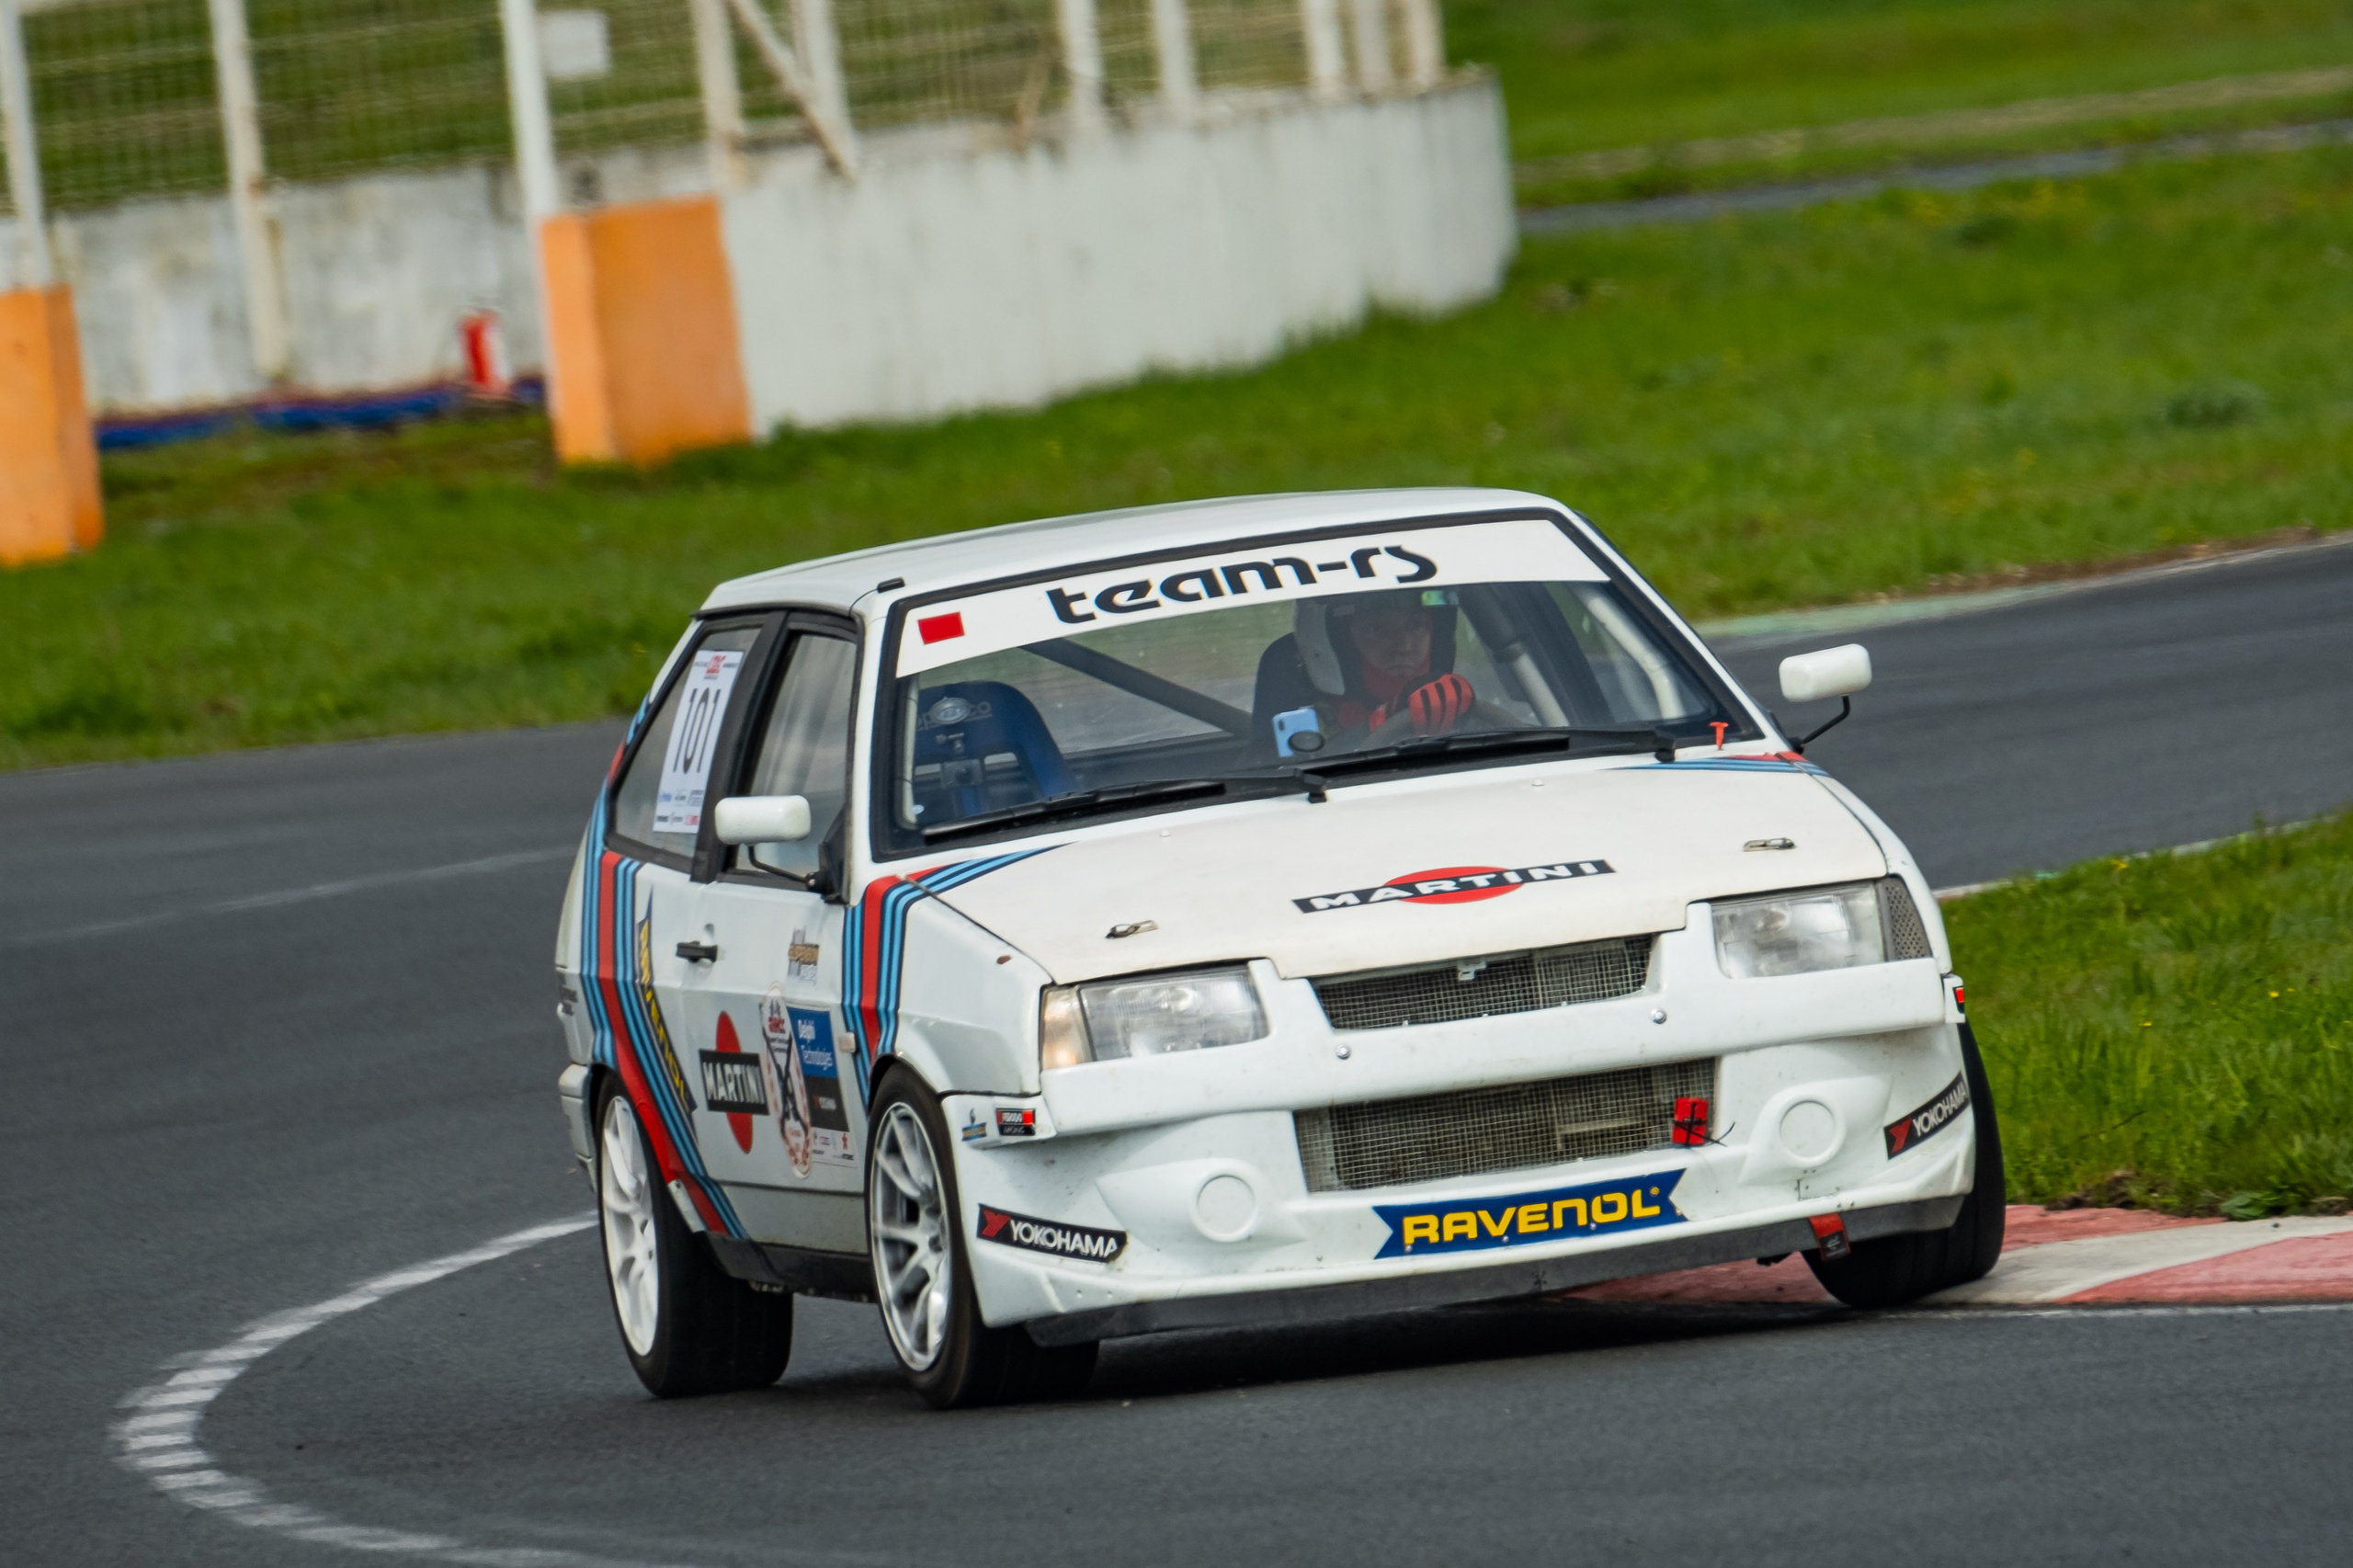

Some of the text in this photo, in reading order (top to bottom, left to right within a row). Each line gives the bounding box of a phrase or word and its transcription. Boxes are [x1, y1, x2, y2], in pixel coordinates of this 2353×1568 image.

[1046, 544, 1438, 624] team-rs
[1308, 861, 1600, 911] MARTINI
[701, 1061, 767, 1105] MARTINI
[1912, 1082, 1969, 1138] YOKOHAMA
[1010, 1219, 1119, 1258] YOKOHAMA
[1403, 1188, 1662, 1245] RAVENOL
